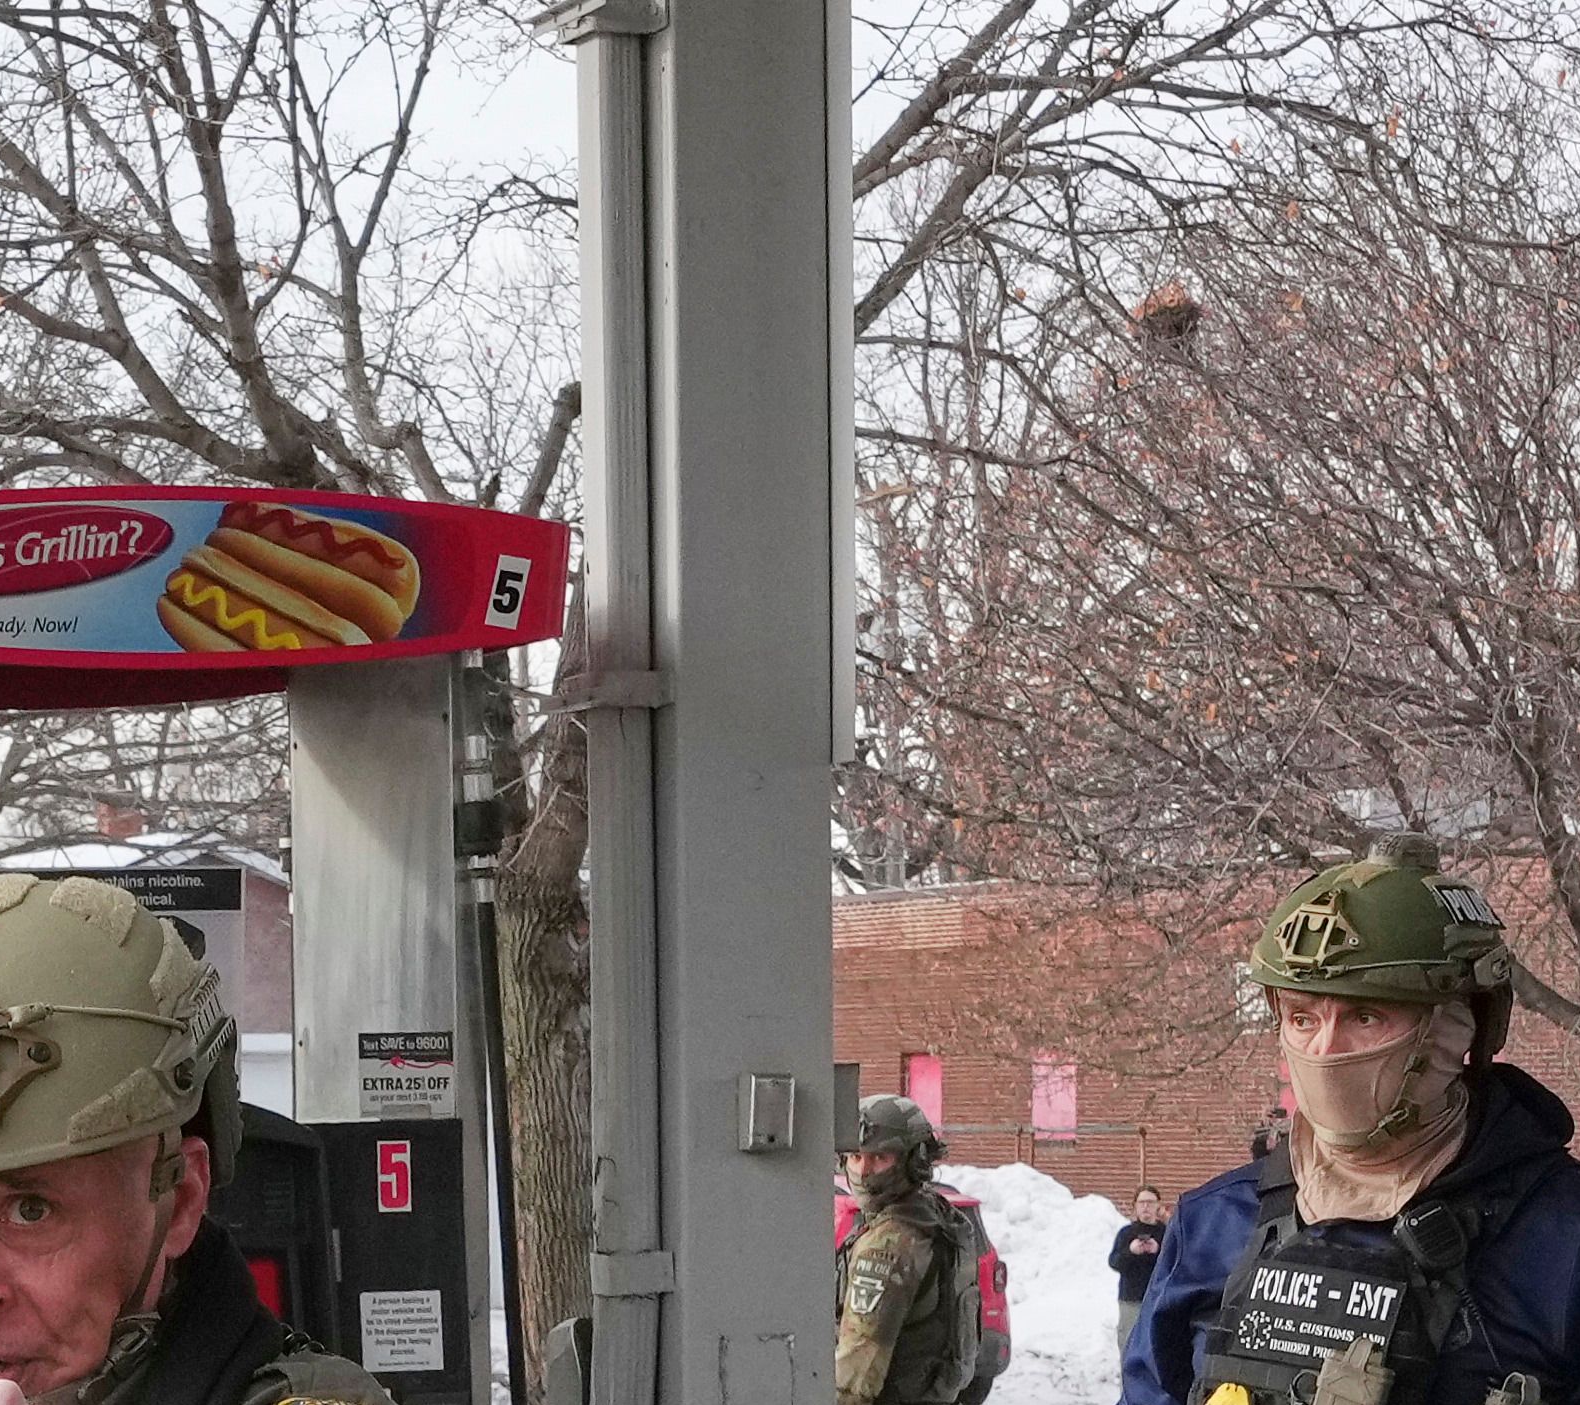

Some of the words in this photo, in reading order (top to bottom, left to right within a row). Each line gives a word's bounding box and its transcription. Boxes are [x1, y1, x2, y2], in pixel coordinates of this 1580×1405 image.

[15, 521, 144, 567] Grillin'?
[493, 570, 524, 614] 5
[33, 616, 78, 633] Now!
[149, 874, 204, 887] nicotine.
[380, 1037, 405, 1050] SAVE
[416, 1036, 449, 1050] 96001
[363, 1077, 403, 1091] EXTRA
[428, 1077, 450, 1090] OFF
[380, 1144, 409, 1209] 5
[1250, 1267, 1323, 1309] POLICE
[1346, 1281, 1398, 1321] EMT
[1273, 1317, 1296, 1332] U.S.
[1299, 1321, 1355, 1342] CUSTOMS
[1269, 1338, 1310, 1356] BORDER
